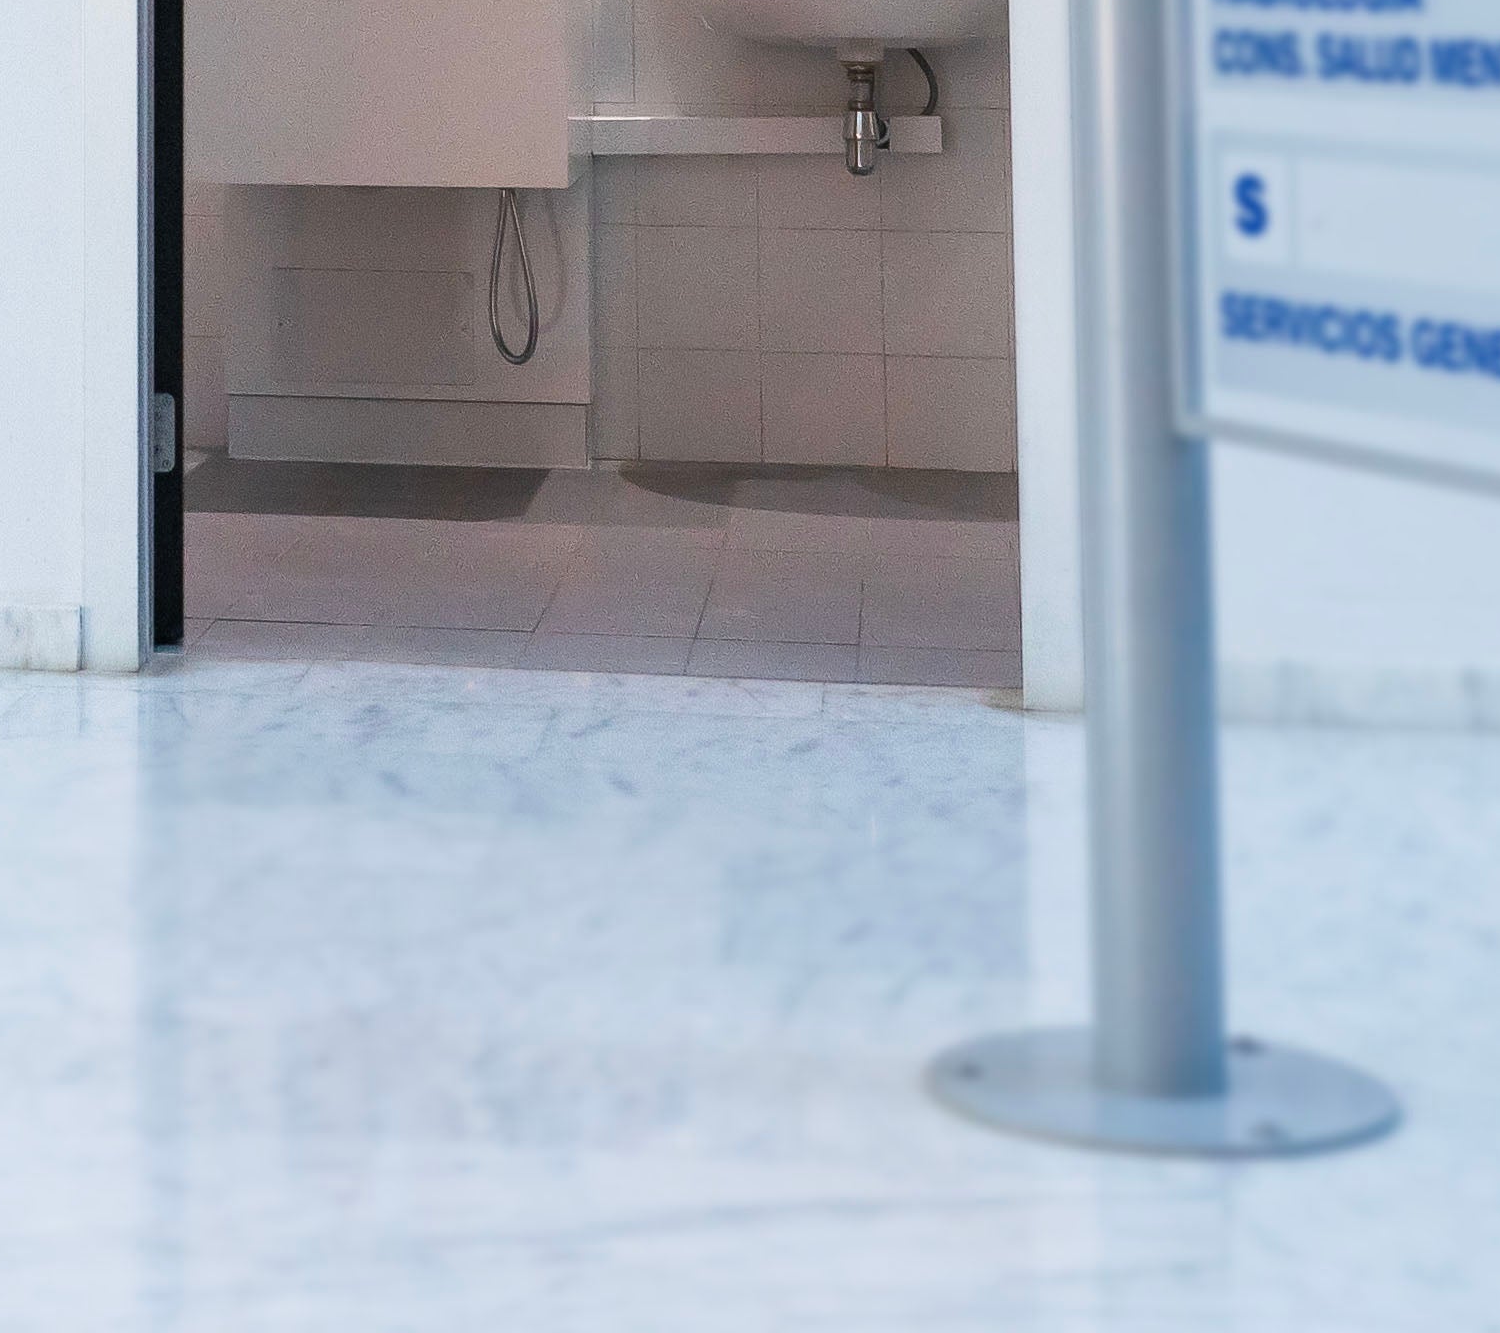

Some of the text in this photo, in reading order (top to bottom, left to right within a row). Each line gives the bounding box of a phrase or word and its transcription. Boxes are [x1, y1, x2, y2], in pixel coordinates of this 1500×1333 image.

[1214, 30, 1307, 79] CONS.
[1316, 32, 1422, 83] SALUD
[1234, 172, 1269, 237] S
[1220, 290, 1401, 364] SERVICIOS
